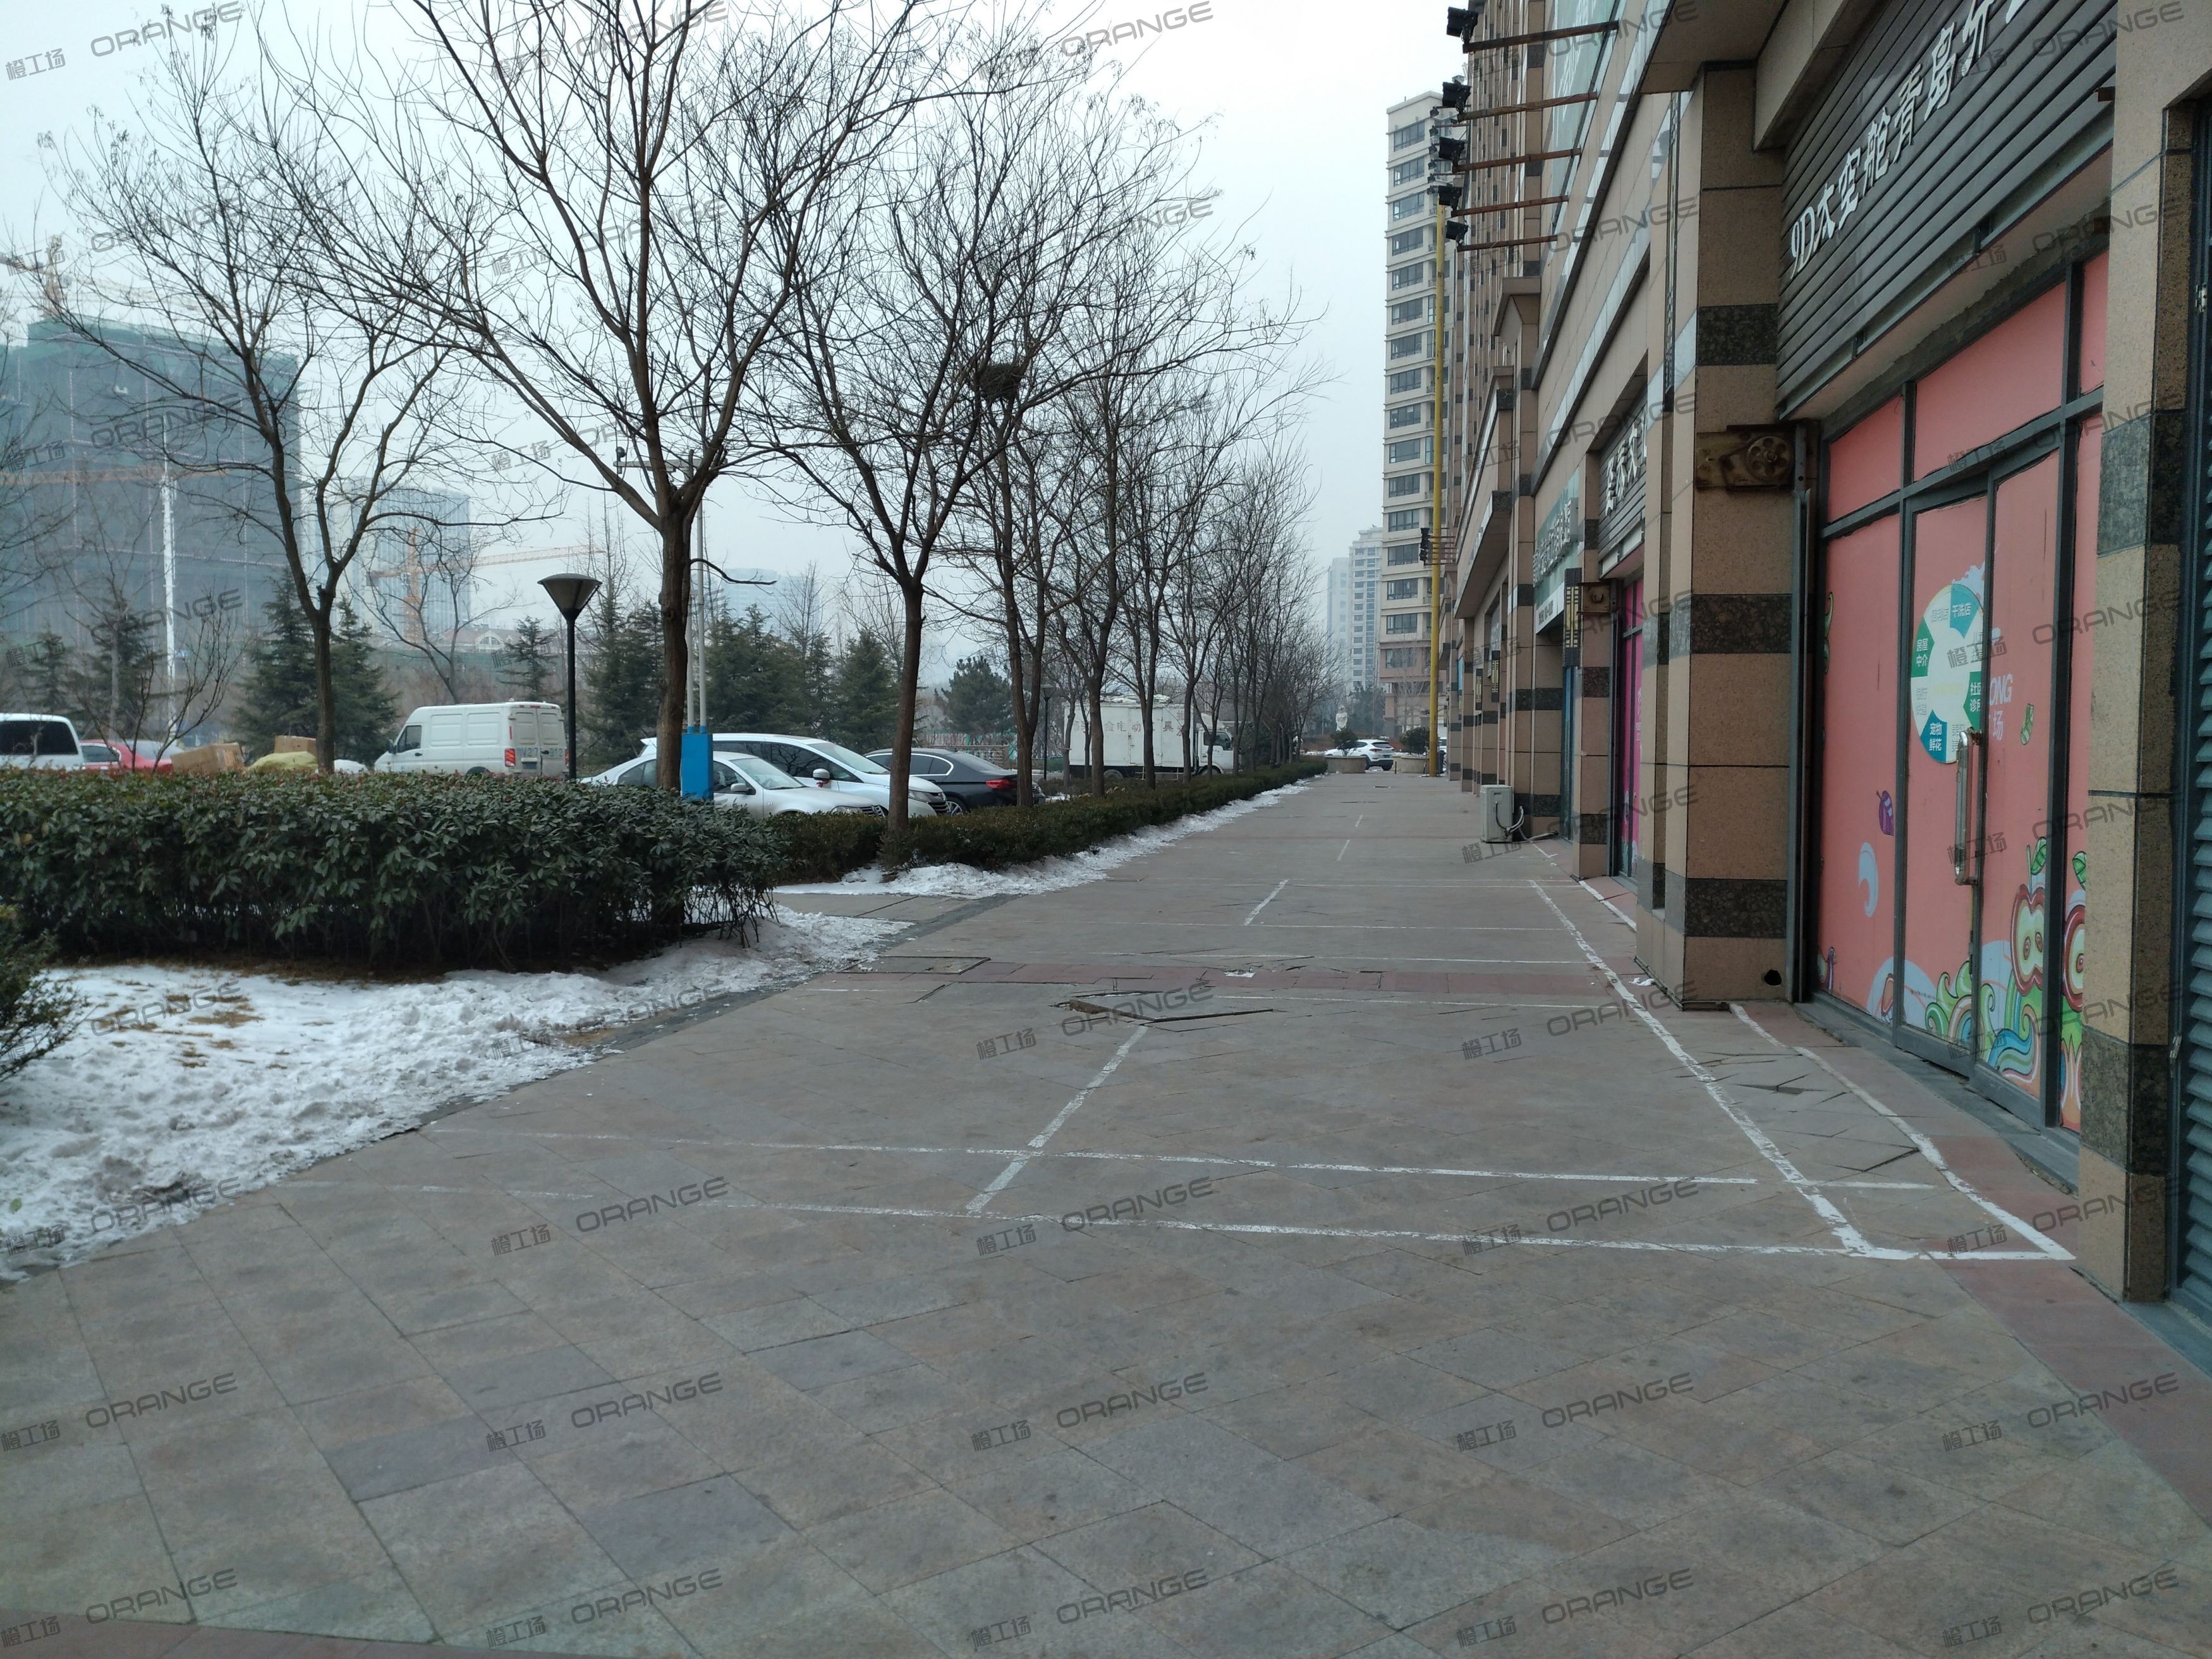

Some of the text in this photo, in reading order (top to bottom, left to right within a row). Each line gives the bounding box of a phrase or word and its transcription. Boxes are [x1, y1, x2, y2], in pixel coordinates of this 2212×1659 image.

[1791, 0, 2023, 279] 9D太空舱青岛
[1952, 603, 1971, 617] 干洗店
[1917, 638, 1928, 652] 房屋
[1917, 653, 1928, 667] 中介
[1970, 682, 1981, 696] 社区
[1929, 722, 1943, 736] 宠物
[1989, 710, 2003, 741] 场
[1929, 738, 1942, 751] 鲜花
